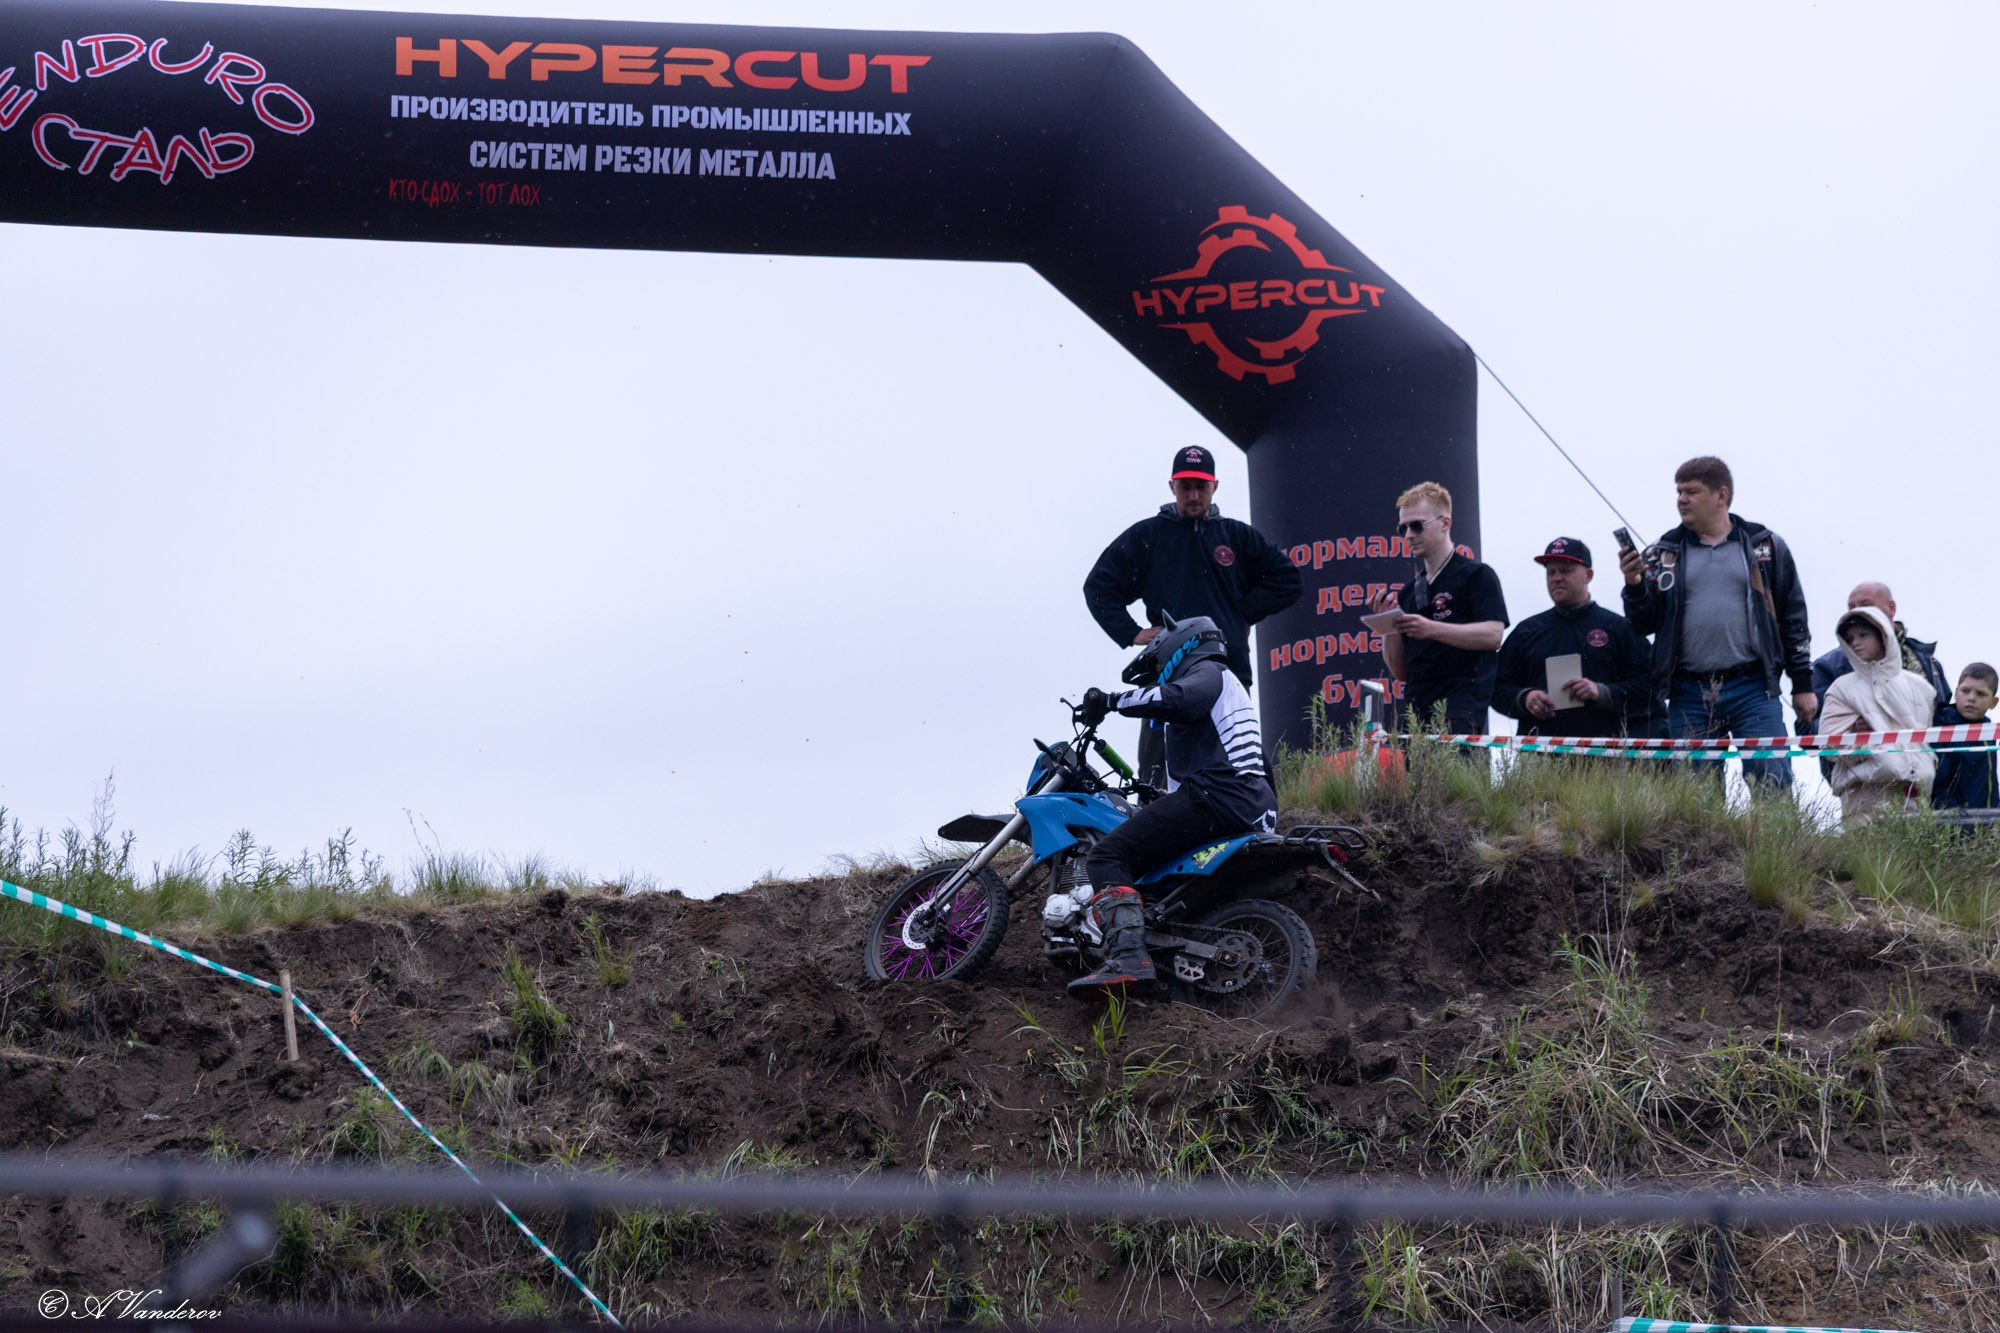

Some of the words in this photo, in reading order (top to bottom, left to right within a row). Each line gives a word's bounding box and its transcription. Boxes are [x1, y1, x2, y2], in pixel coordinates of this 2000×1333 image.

[0, 33, 314, 134] ENDURO
[395, 36, 932, 94] HYPERCUT
[390, 94, 645, 128] ПРОИЗВОДИТЕЛЬ
[651, 104, 912, 136] ПРОМЫШЛЕННЫХ
[469, 140, 588, 172] СИСТЕМ
[594, 144, 692, 175] РЕЗКИ
[699, 148, 837, 180] МЕТАЛЛА
[388, 178, 417, 202] КТО
[1132, 279, 1386, 317] HYPERCUT
[1157, 635, 1200, 687] 100%
